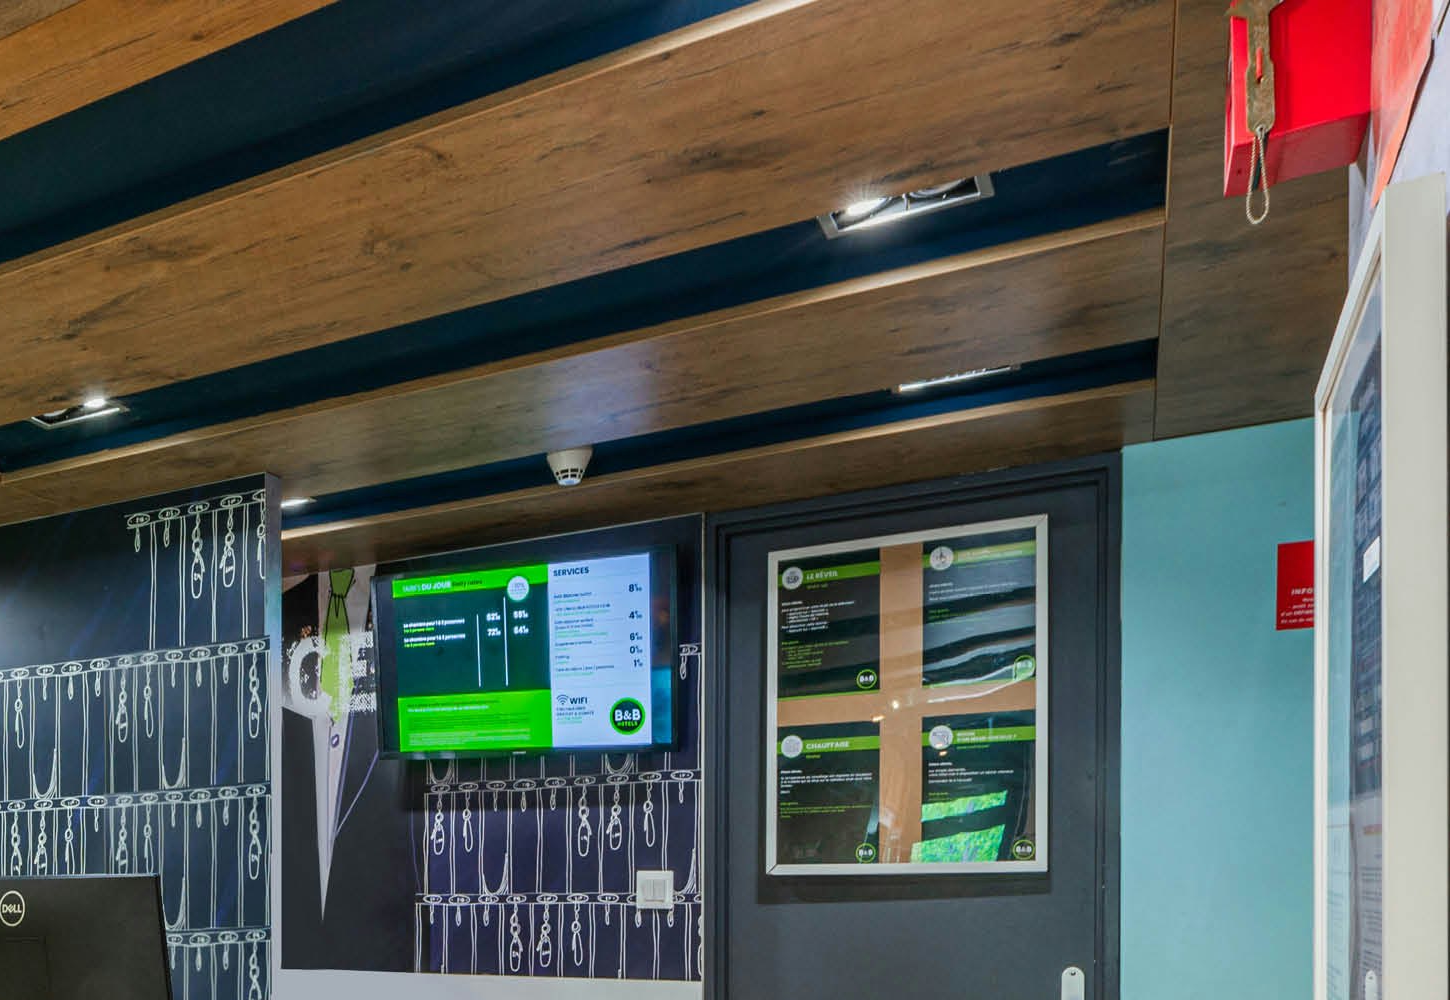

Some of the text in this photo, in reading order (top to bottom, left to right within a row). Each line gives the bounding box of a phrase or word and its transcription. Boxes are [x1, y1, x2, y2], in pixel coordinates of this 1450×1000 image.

[553, 566, 590, 577] SERVICES
[569, 696, 588, 705] WIFI
[614, 708, 641, 722] B&B
[2, 903, 23, 914] DELL
